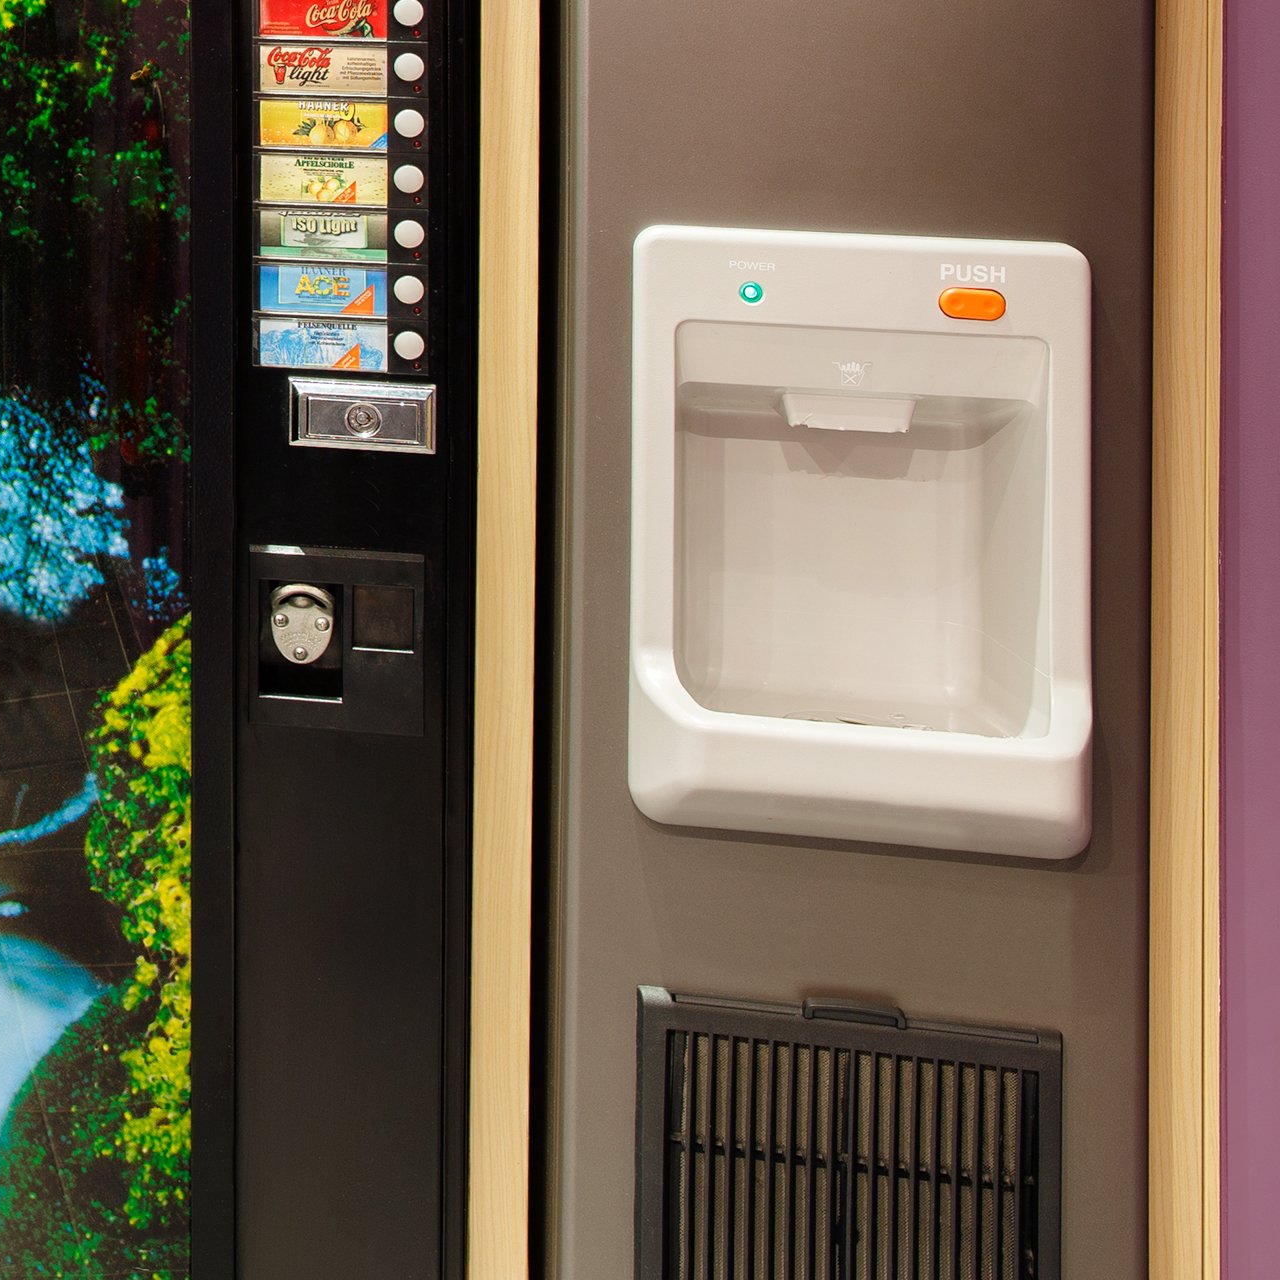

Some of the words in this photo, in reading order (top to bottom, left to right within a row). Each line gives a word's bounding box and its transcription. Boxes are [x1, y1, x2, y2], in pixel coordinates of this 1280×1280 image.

[267, 46, 333, 68] Coca-Cola
[290, 65, 330, 86] light
[298, 101, 348, 112] HAANER
[294, 159, 354, 169] APFELSCHORLE
[319, 216, 358, 235] Light
[729, 260, 776, 272] POWER
[940, 264, 1006, 284] PUSH
[295, 275, 351, 297] ACE
[298, 322, 357, 330] FELSENQUELLE
